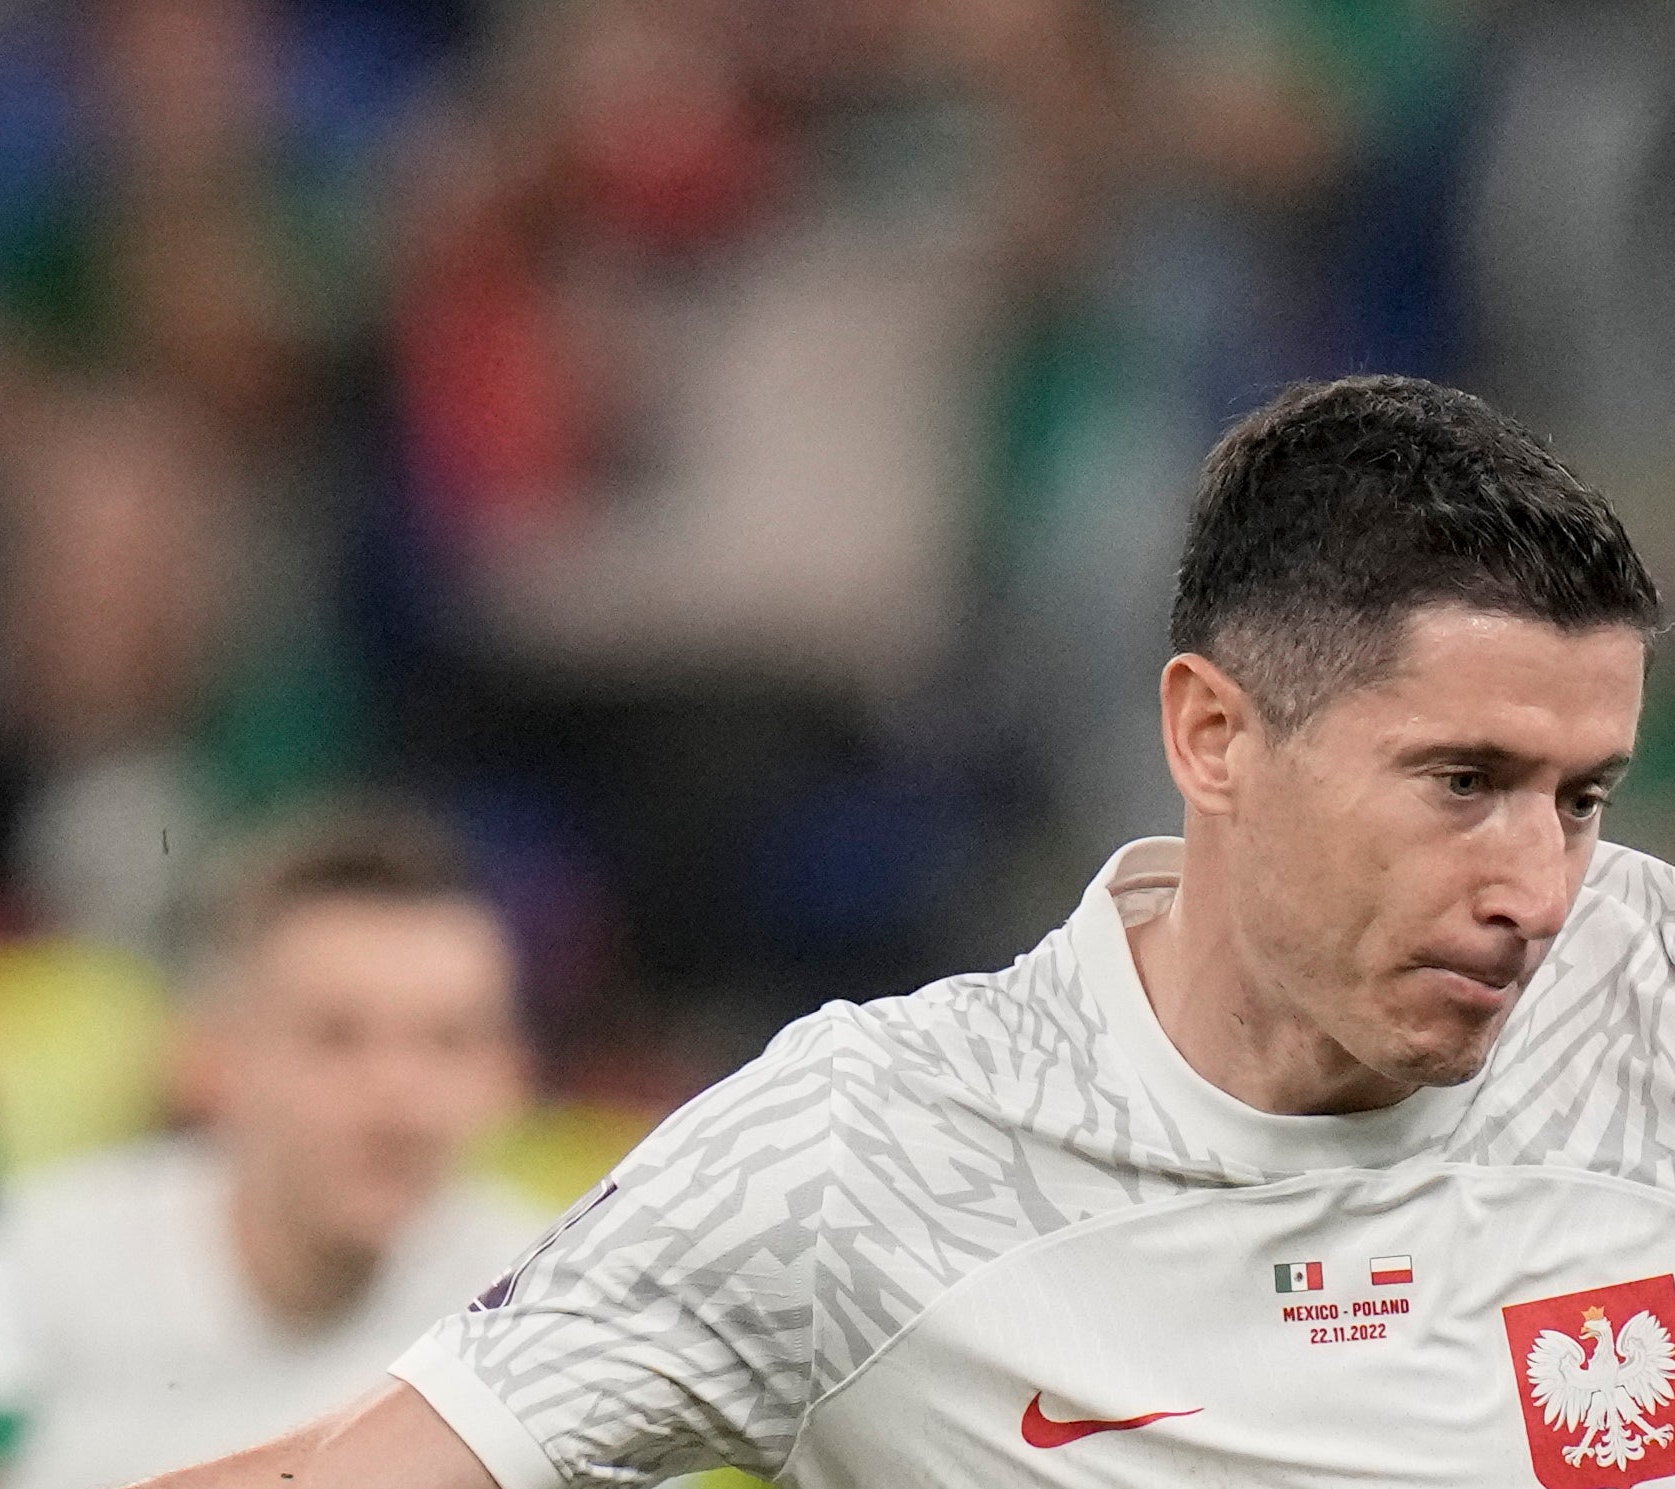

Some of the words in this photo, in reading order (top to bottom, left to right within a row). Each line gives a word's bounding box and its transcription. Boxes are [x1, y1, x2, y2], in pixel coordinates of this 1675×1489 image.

[1282, 1304, 1339, 1322] MEXICO
[1352, 1298, 1409, 1317] POLAND
[1310, 1323, 1387, 1344] 22.11.2022
